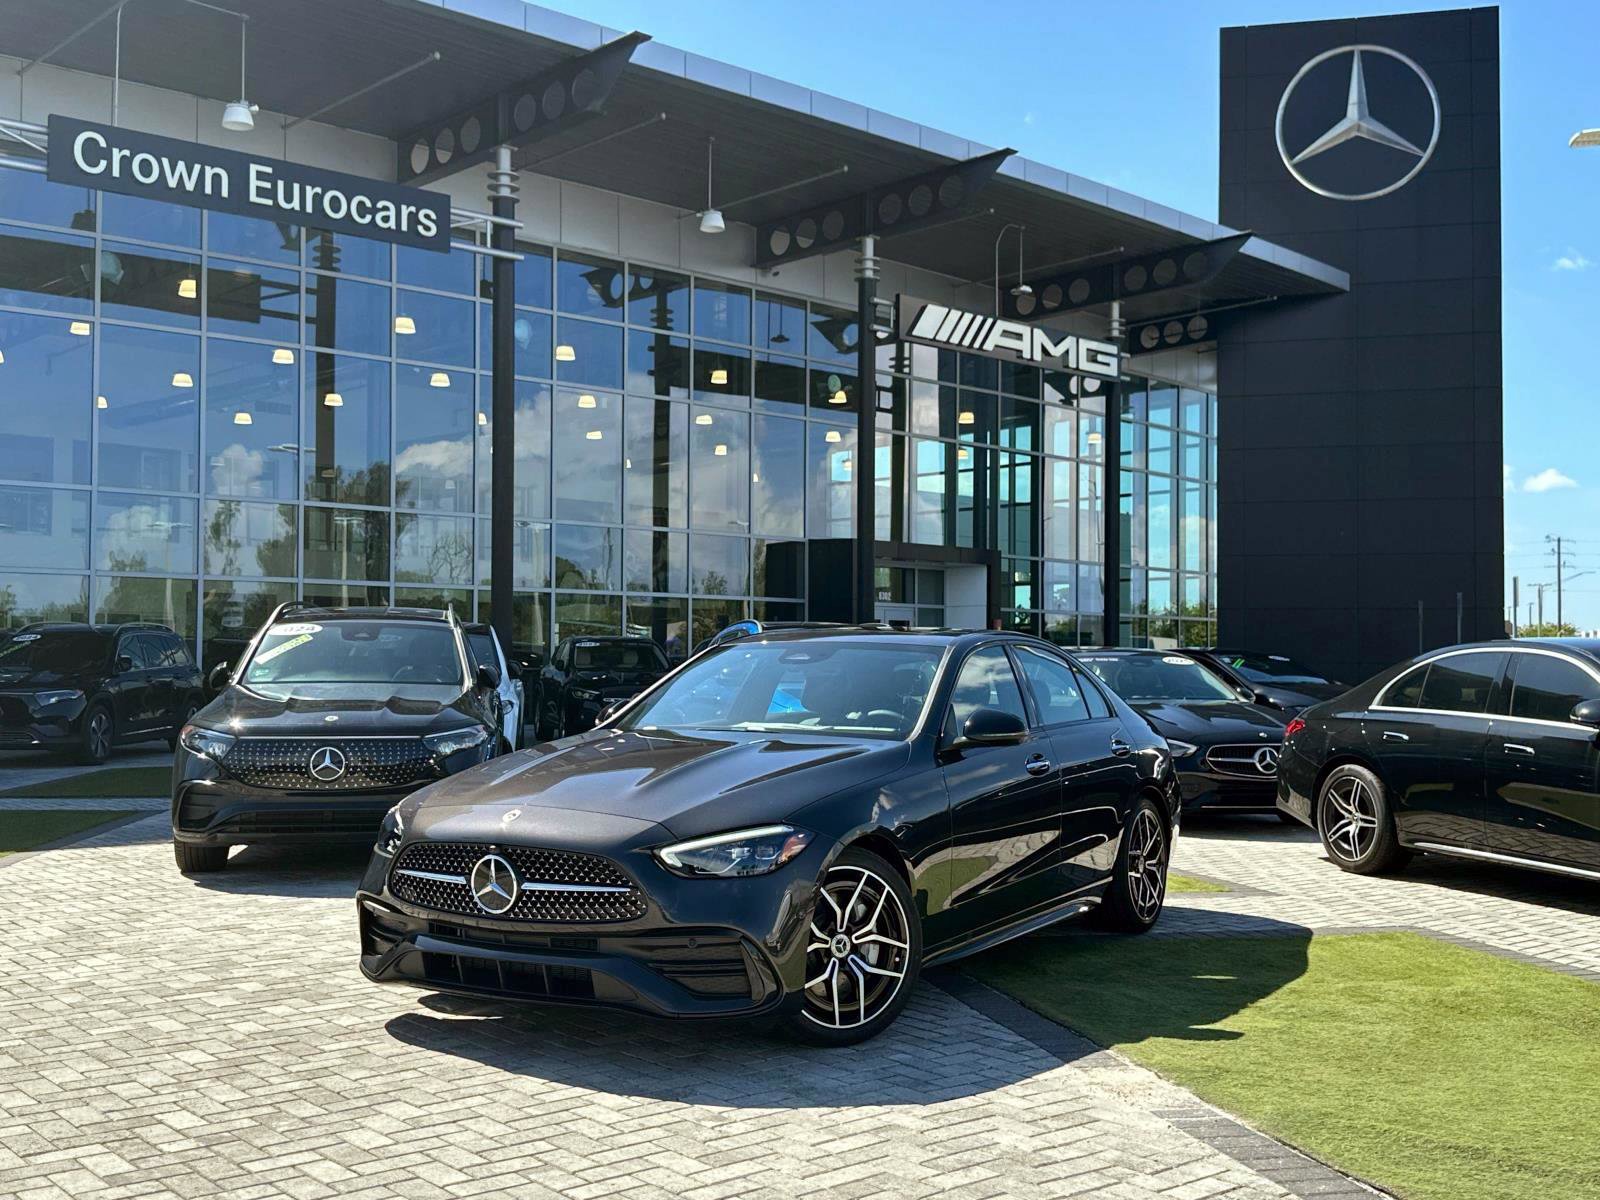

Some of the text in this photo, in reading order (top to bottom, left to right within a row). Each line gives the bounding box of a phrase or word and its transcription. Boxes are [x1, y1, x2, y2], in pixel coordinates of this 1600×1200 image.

[72, 129, 438, 238] Crown Eurocars
[982, 319, 1118, 377] AMG
